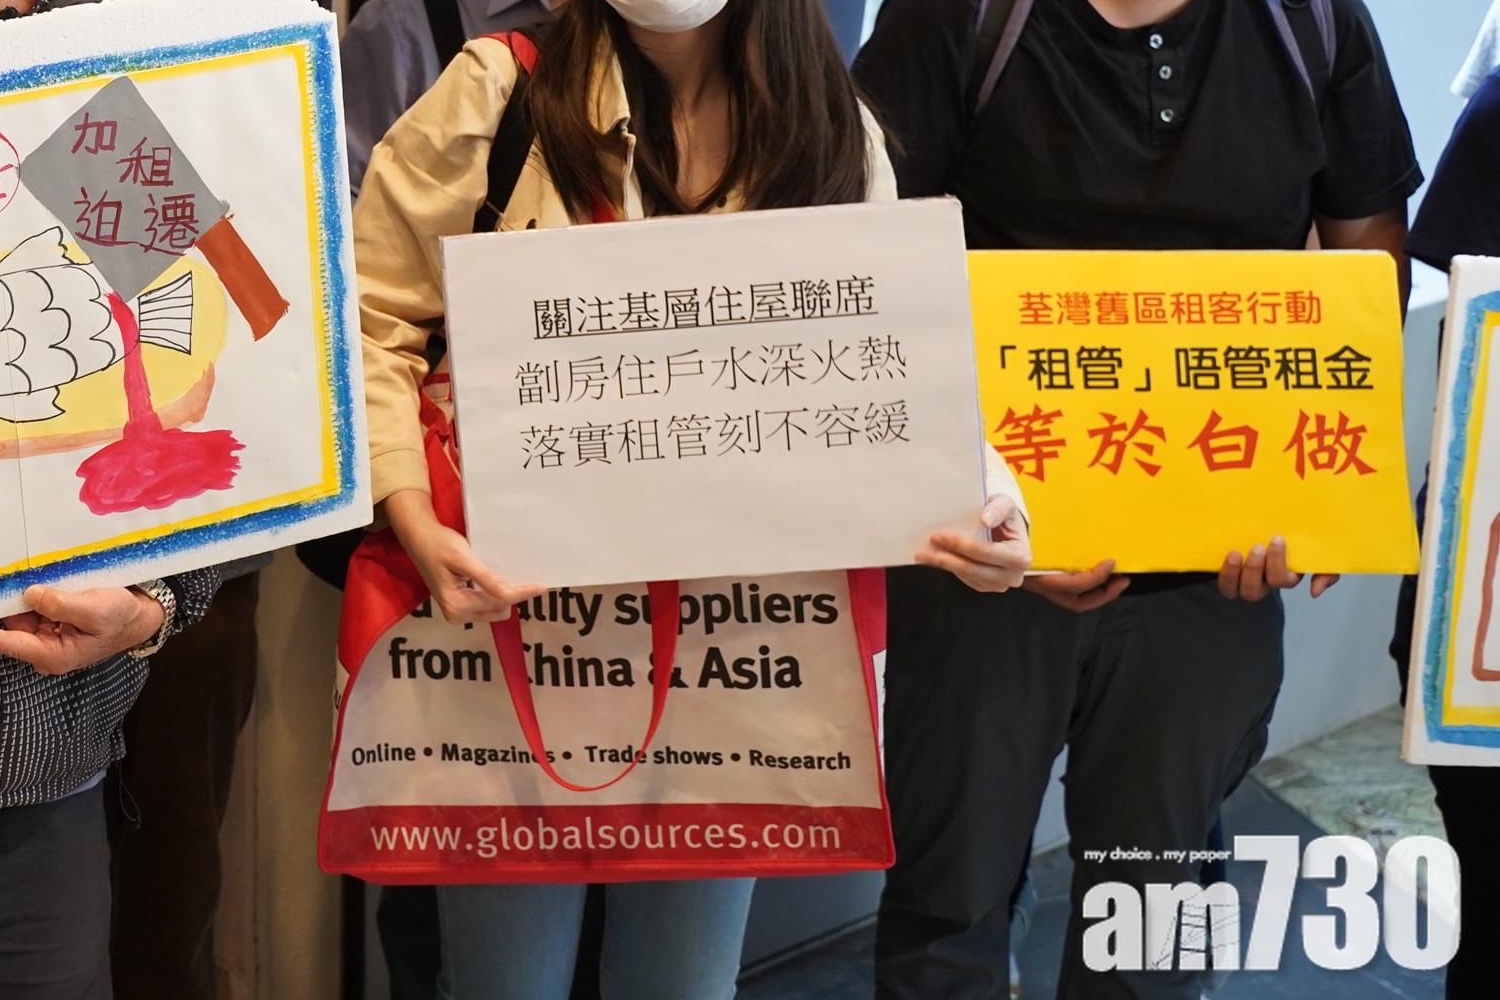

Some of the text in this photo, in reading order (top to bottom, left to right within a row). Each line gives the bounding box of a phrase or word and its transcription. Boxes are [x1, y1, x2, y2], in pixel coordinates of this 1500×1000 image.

[533, 274, 879, 340] 關注基層住屋聯席
[1018, 290, 1323, 327] 荃灣舊區租客行動
[514, 334, 907, 407] 劏房住戶水深火熱
[1000, 344, 1374, 393] 「租管」唔管租金
[518, 399, 911, 471] 落實租管刻不容緩
[992, 402, 1379, 484] 等於白做
[389, 636, 492, 682] from
[698, 644, 803, 690] Asia
[351, 743, 416, 767] Online
[653, 746, 724, 766] shows
[749, 749, 851, 771] Research
[370, 815, 841, 859] www.globalsources.com
